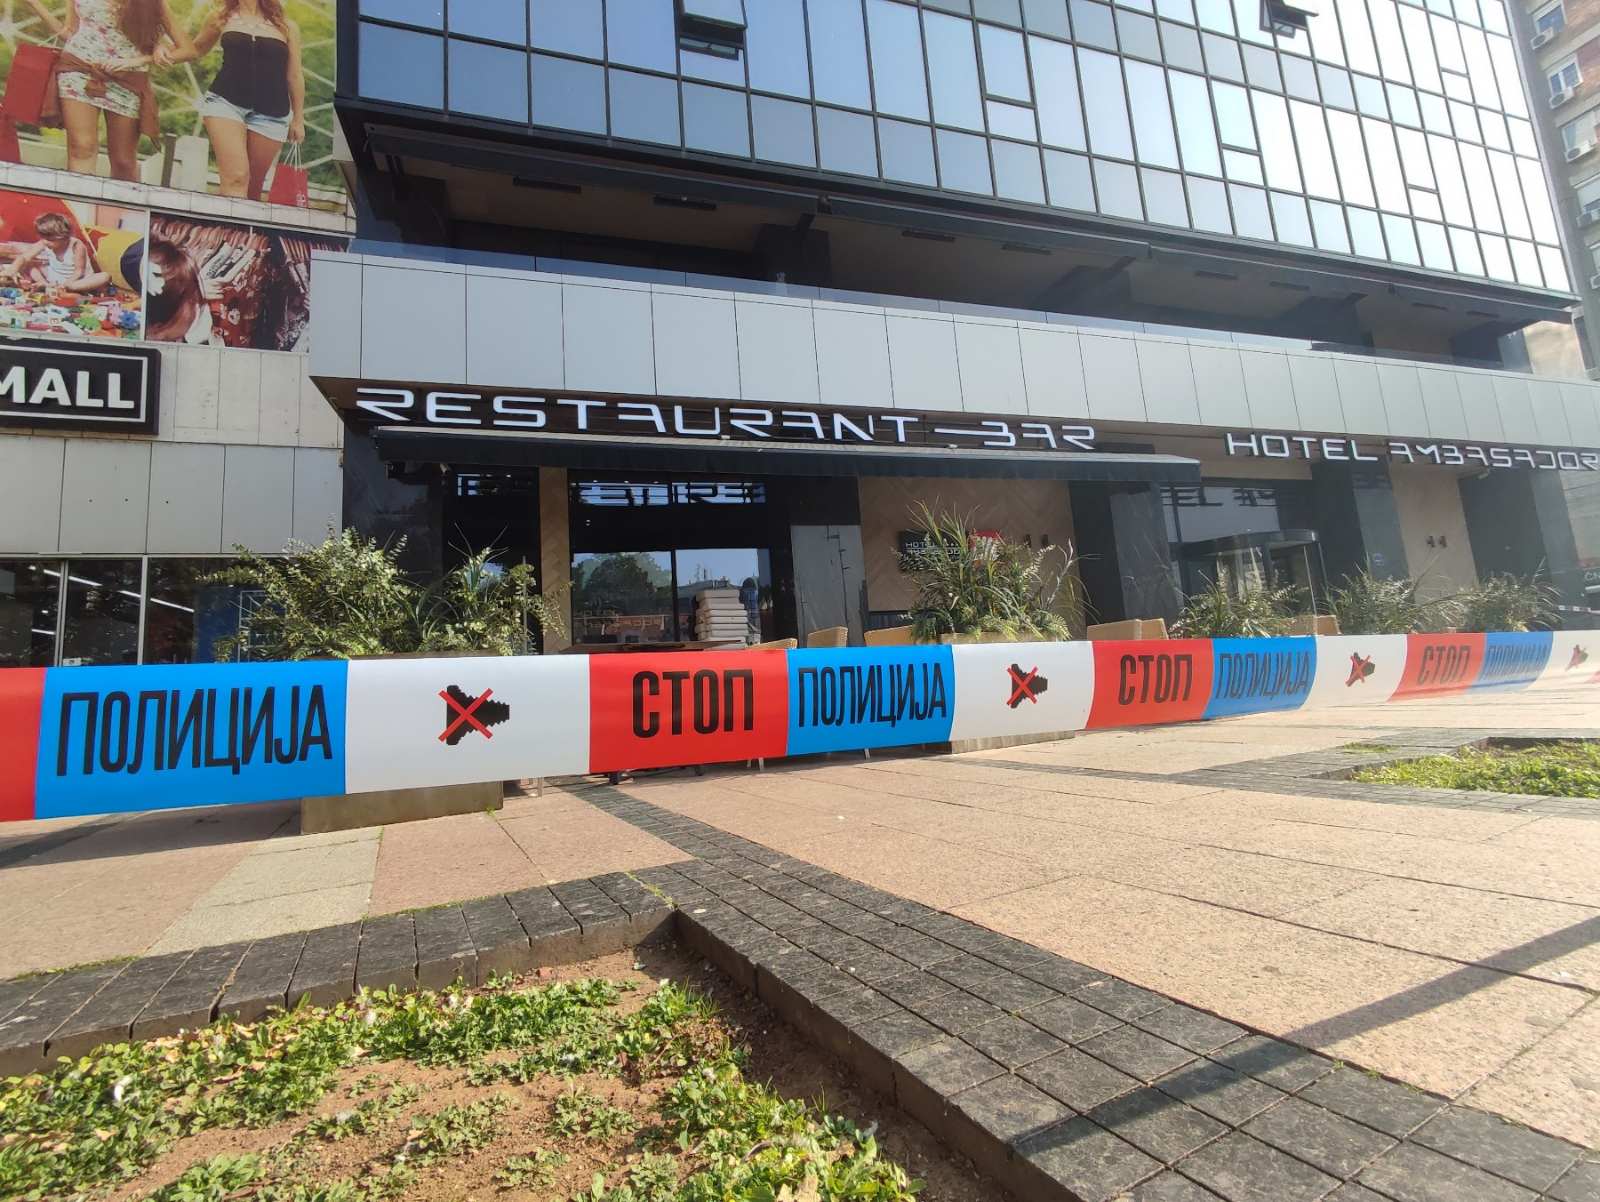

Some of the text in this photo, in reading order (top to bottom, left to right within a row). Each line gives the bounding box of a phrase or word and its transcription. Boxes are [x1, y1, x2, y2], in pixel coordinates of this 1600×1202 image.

[356, 388, 1095, 449] RESTAURANT BAR
[1226, 433, 1600, 471] HOTEL AMBASADOR
[1118, 654, 1193, 705] СТОП
[1215, 652, 1310, 700] ПОЛИЦИЈА
[1417, 644, 1471, 685] СТОП
[633, 669, 754, 738] СТОП
[798, 663, 947, 728] ПОЛИЦИЈА
[57, 685, 333, 776] ПОЛИЦИЈА
